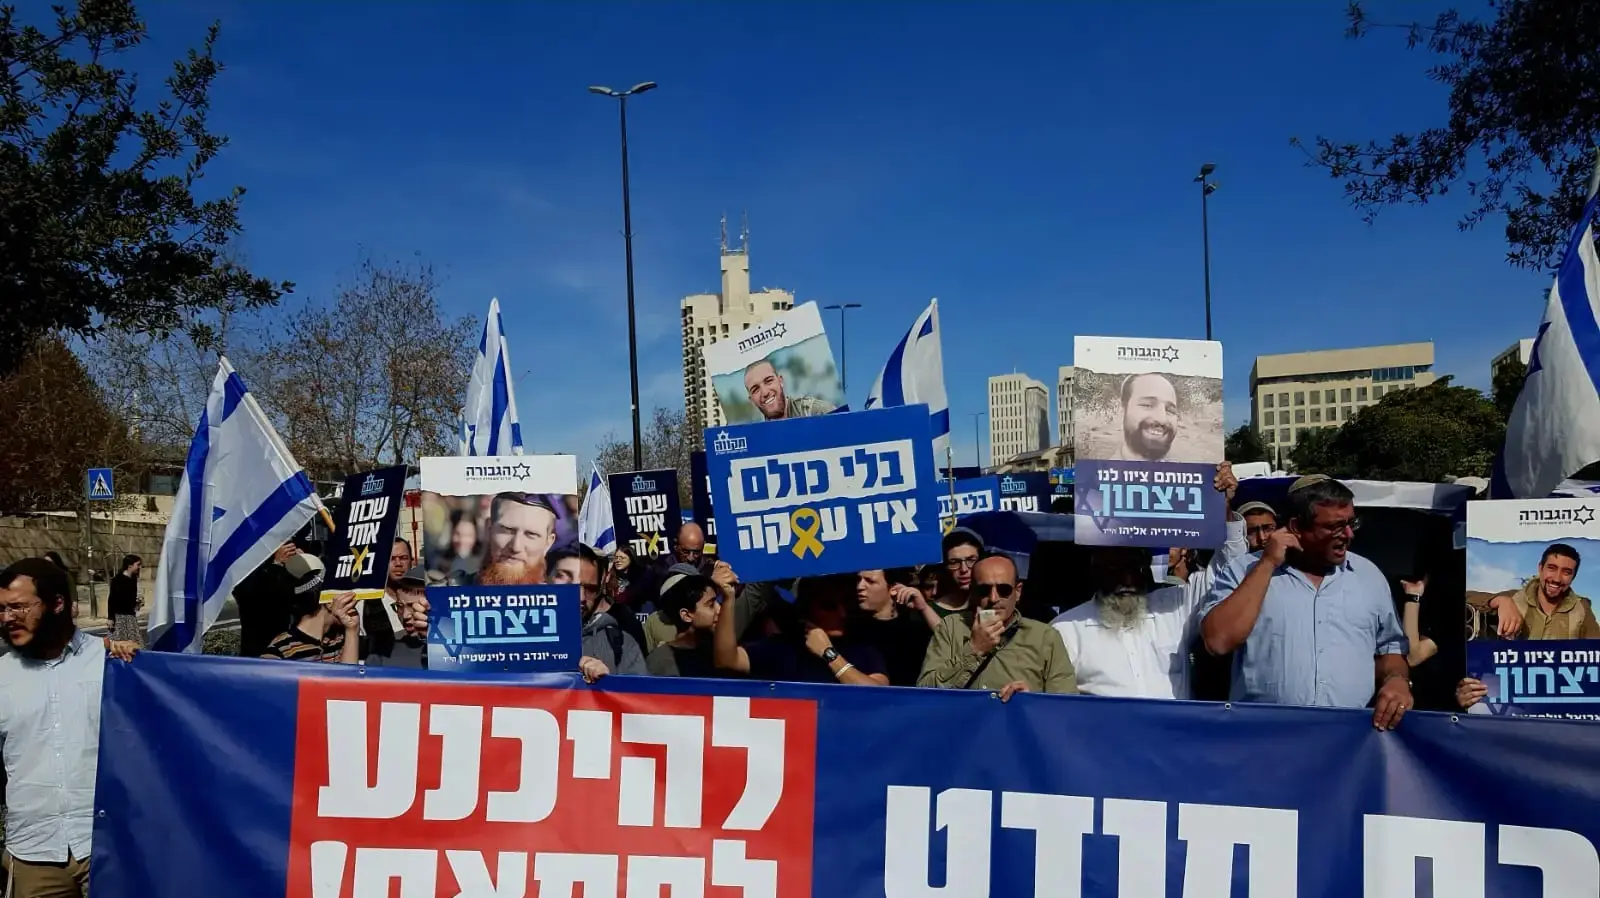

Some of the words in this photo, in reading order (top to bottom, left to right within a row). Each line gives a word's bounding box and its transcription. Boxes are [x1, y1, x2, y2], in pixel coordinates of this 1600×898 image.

[738, 330, 773, 351] הגבורה
[1118, 346, 1160, 357] הגבורה
[714, 438, 747, 451] תקווה
[466, 466, 511, 477] הגבורה
[840, 448, 904, 489] בלי
[1097, 468, 1118, 481] לנו
[740, 458, 829, 502] כולם
[1123, 470, 1149, 482] ציוו
[1154, 471, 1203, 484] במותם
[624, 494, 668, 515] שכחו
[962, 494, 988, 509] בלי
[348, 496, 390, 523] שכחו
[1520, 509, 1572, 521] הגבורה
[629, 514, 666, 532] אותי
[858, 499, 919, 544] אין
[347, 522, 381, 547] אותי
[1119, 526, 1147, 536] אליהו
[1150, 527, 1182, 536] ידידיה
[448, 594, 470, 608] לנו
[475, 595, 501, 608] ציוו
[507, 594, 558, 606] במותם
[459, 652, 506, 664] לוינשטיין
[508, 653, 520, 661] רז
[523, 652, 549, 660] יונדב
[1493, 649, 1518, 664] לנו
[1524, 651, 1555, 663] ציוו
[1560, 651, 1600, 663] ותם
[317, 696, 786, 831] להיכנע
